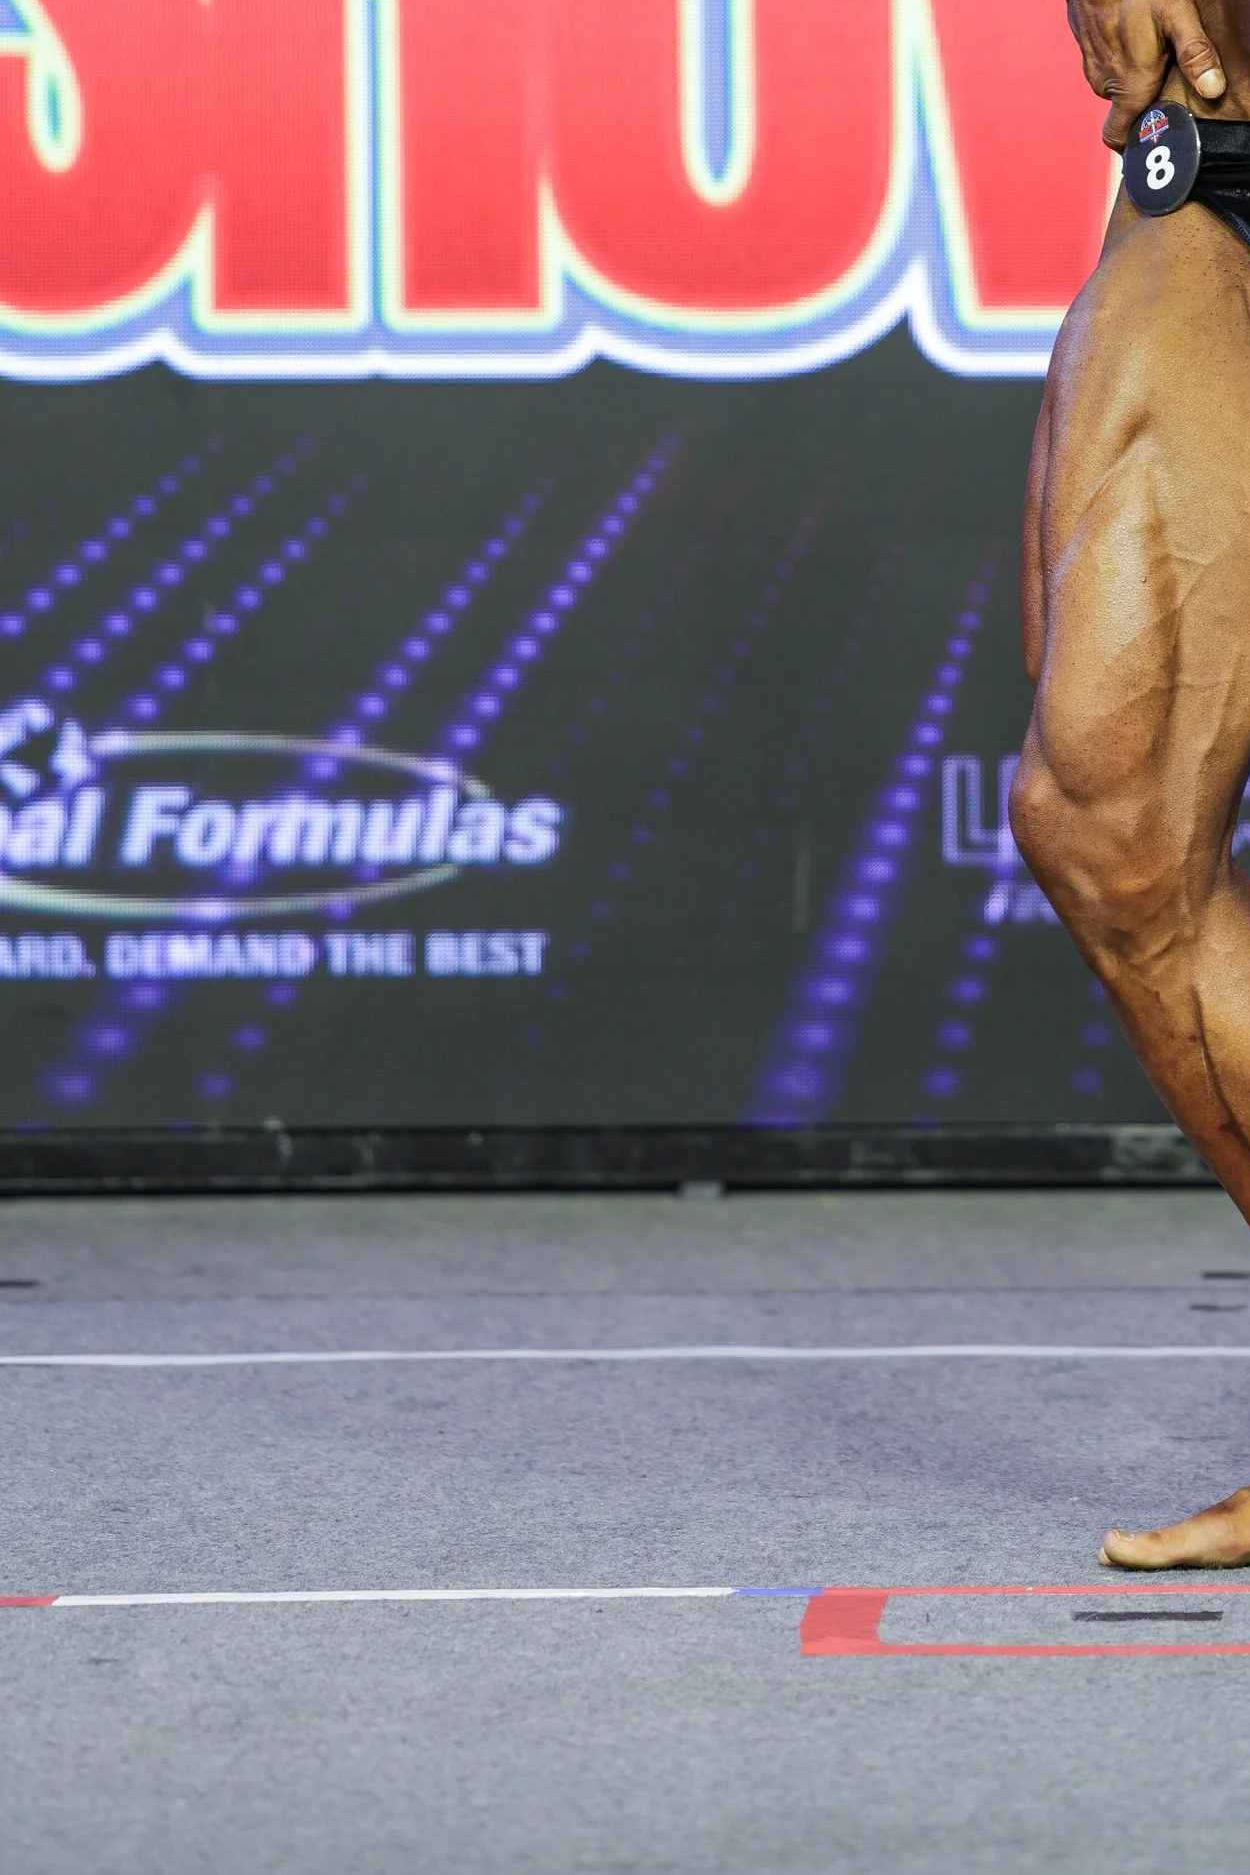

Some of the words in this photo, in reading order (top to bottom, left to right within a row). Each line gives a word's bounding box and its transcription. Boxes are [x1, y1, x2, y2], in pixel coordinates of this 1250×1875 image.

[1145, 145, 1175, 190] 8
[119, 785, 562, 867] Formulas
[322, 929, 416, 978] THE
[424, 928, 548, 977] BEST
